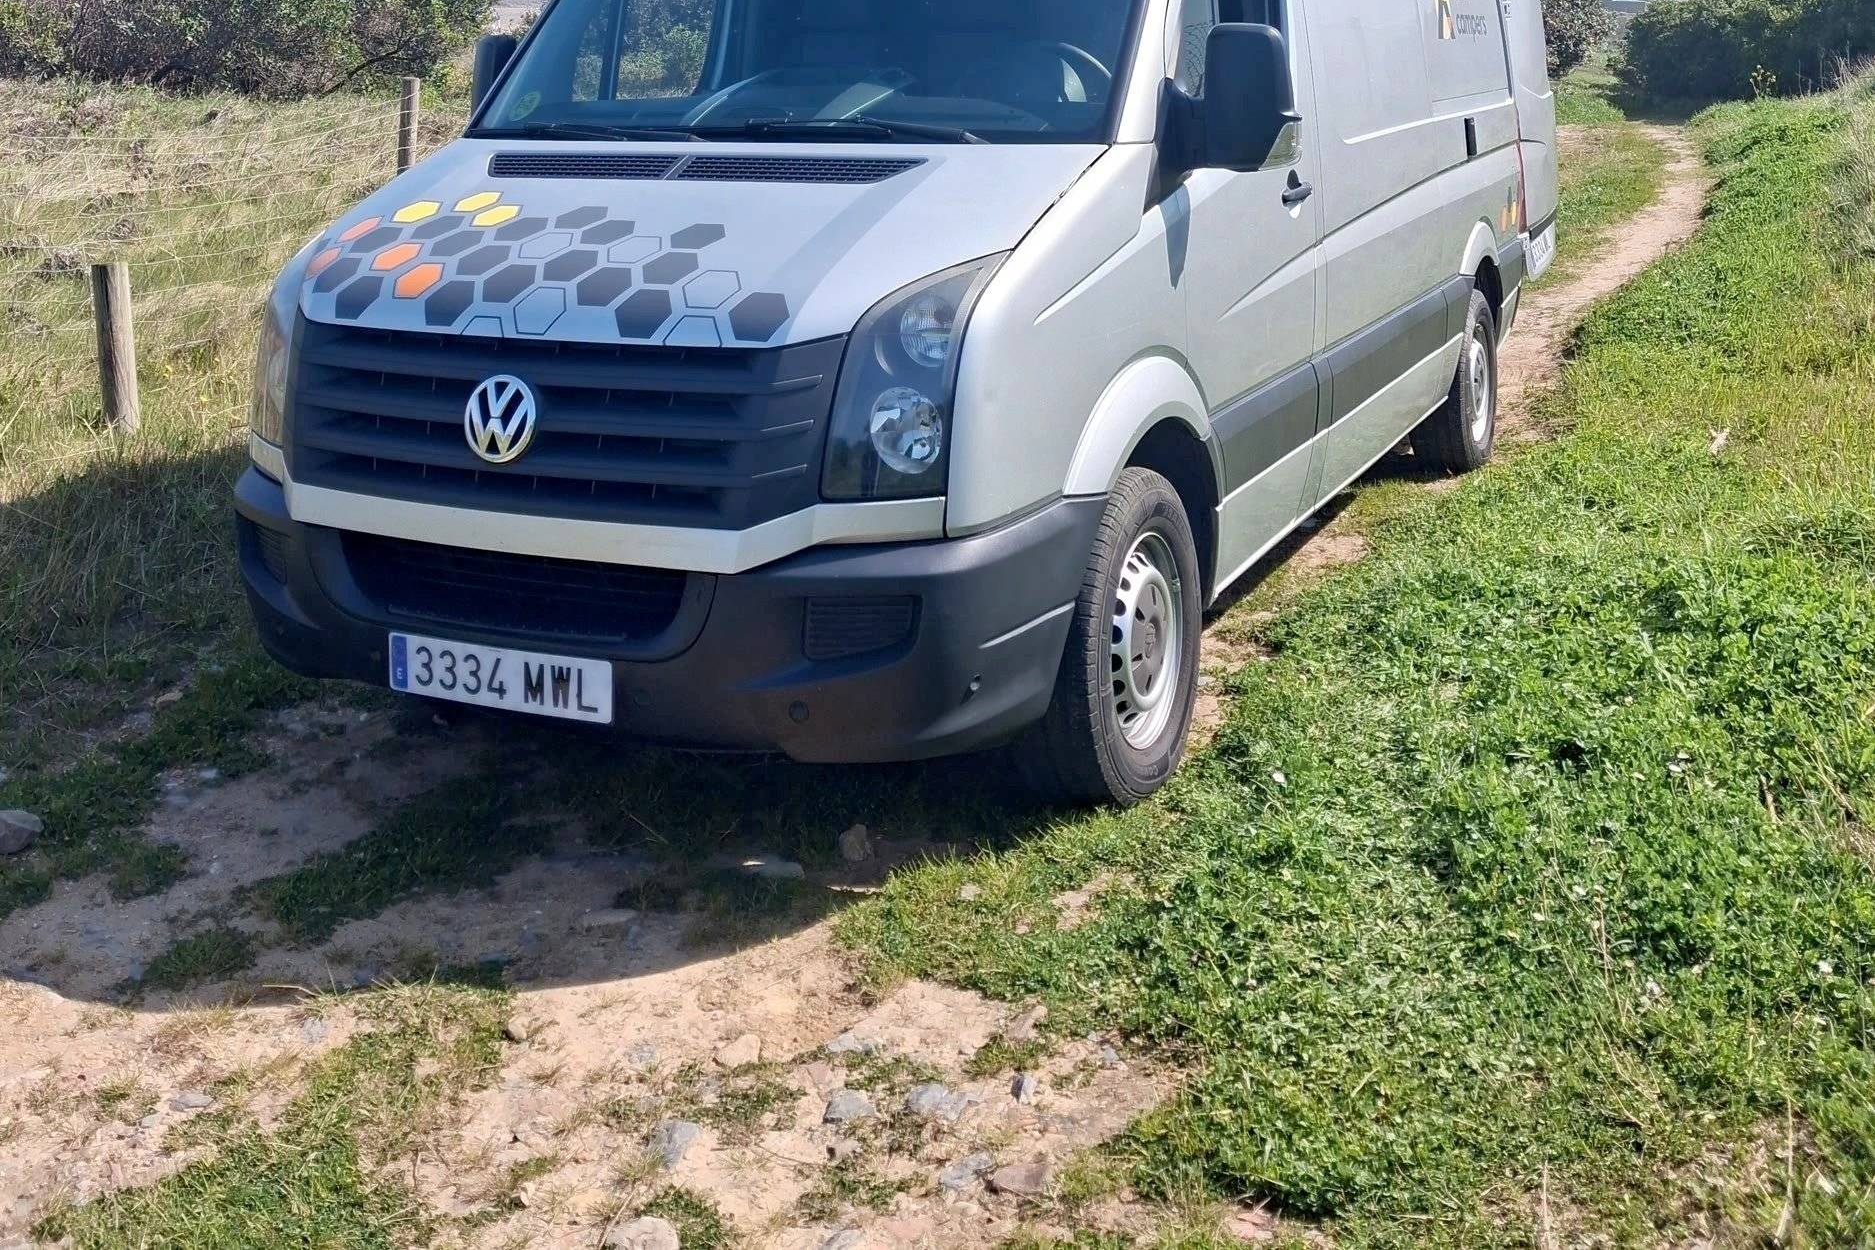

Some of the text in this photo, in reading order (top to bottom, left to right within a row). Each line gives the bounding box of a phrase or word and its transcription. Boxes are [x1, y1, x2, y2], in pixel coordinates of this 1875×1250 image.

[1456, 14, 1487, 45] campers
[464, 374, 536, 463] VW
[396, 667, 404, 680] E
[415, 646, 598, 713] 3334 MWL
